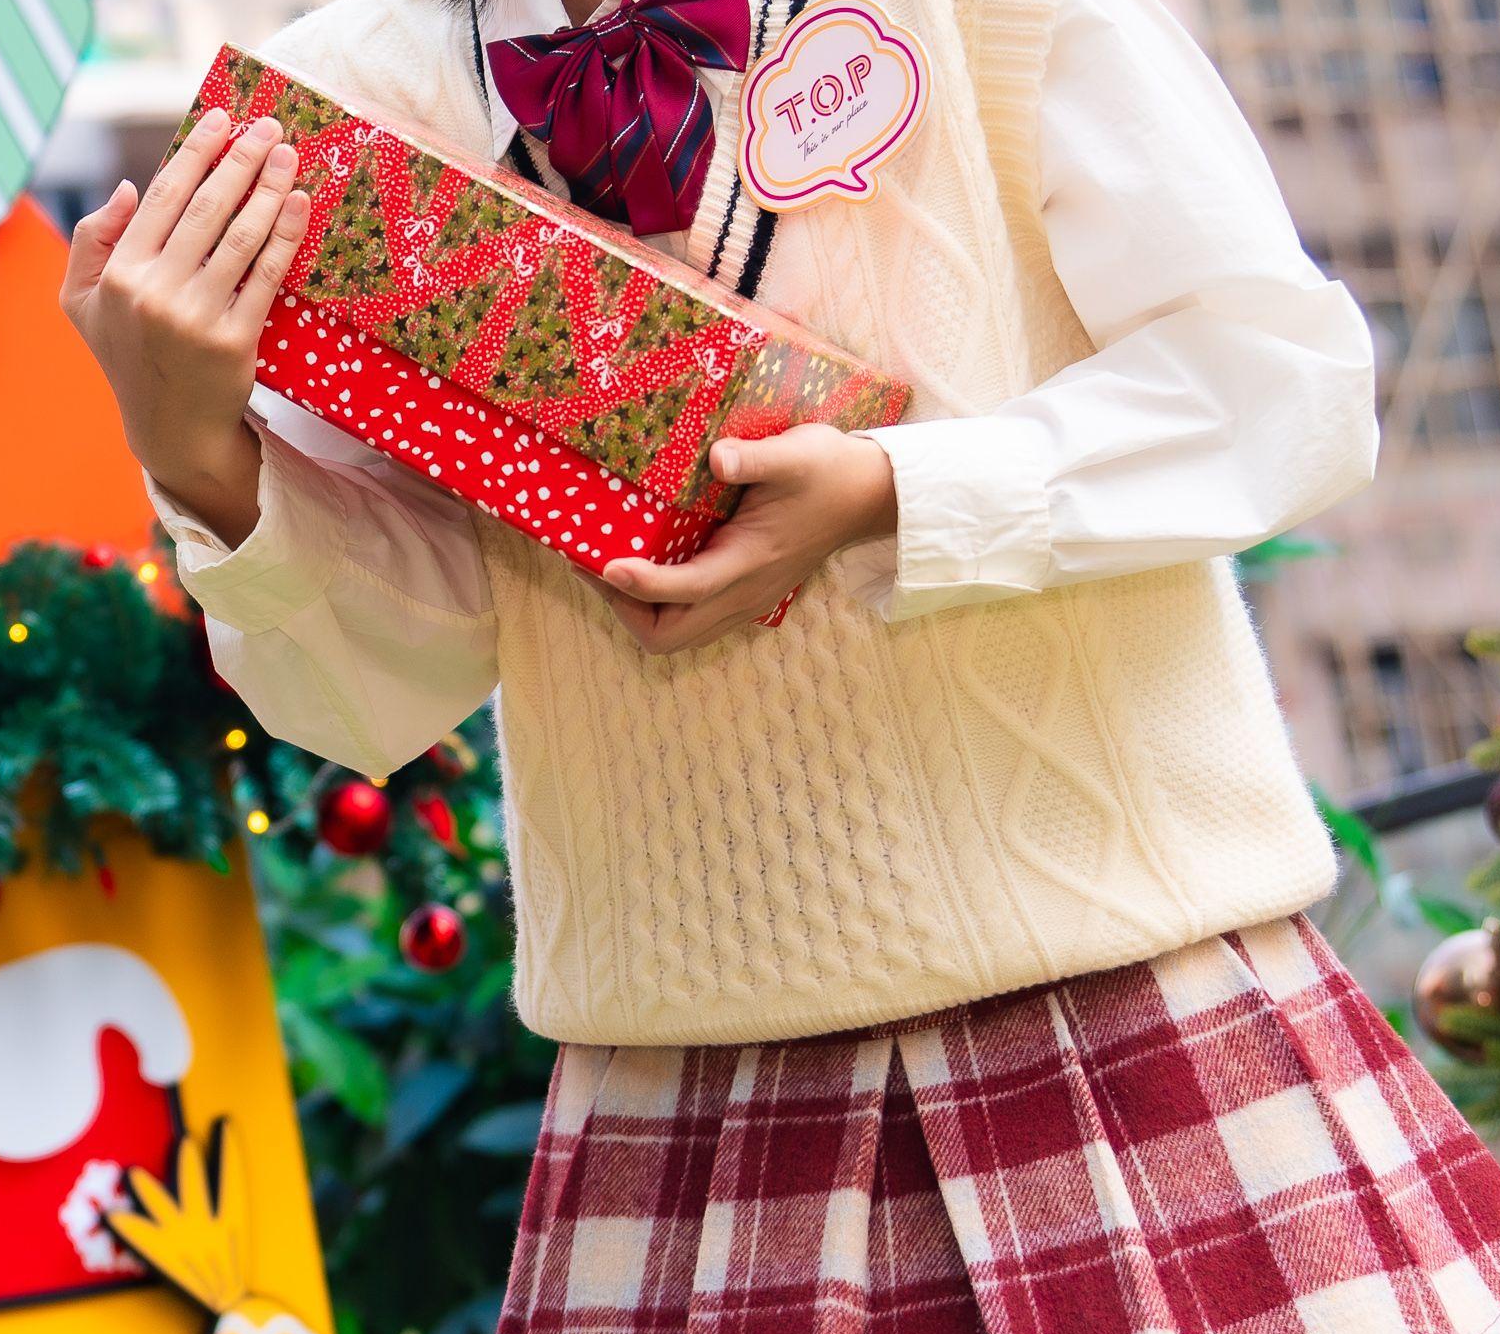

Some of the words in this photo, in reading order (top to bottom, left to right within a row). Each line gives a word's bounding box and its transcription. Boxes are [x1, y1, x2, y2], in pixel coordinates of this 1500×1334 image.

[774, 54, 871, 135] T.O.P
[797, 132, 819, 162] This
[821, 133, 829, 143] is
[831, 120, 844, 134] our
[846, 100, 868, 128] place
